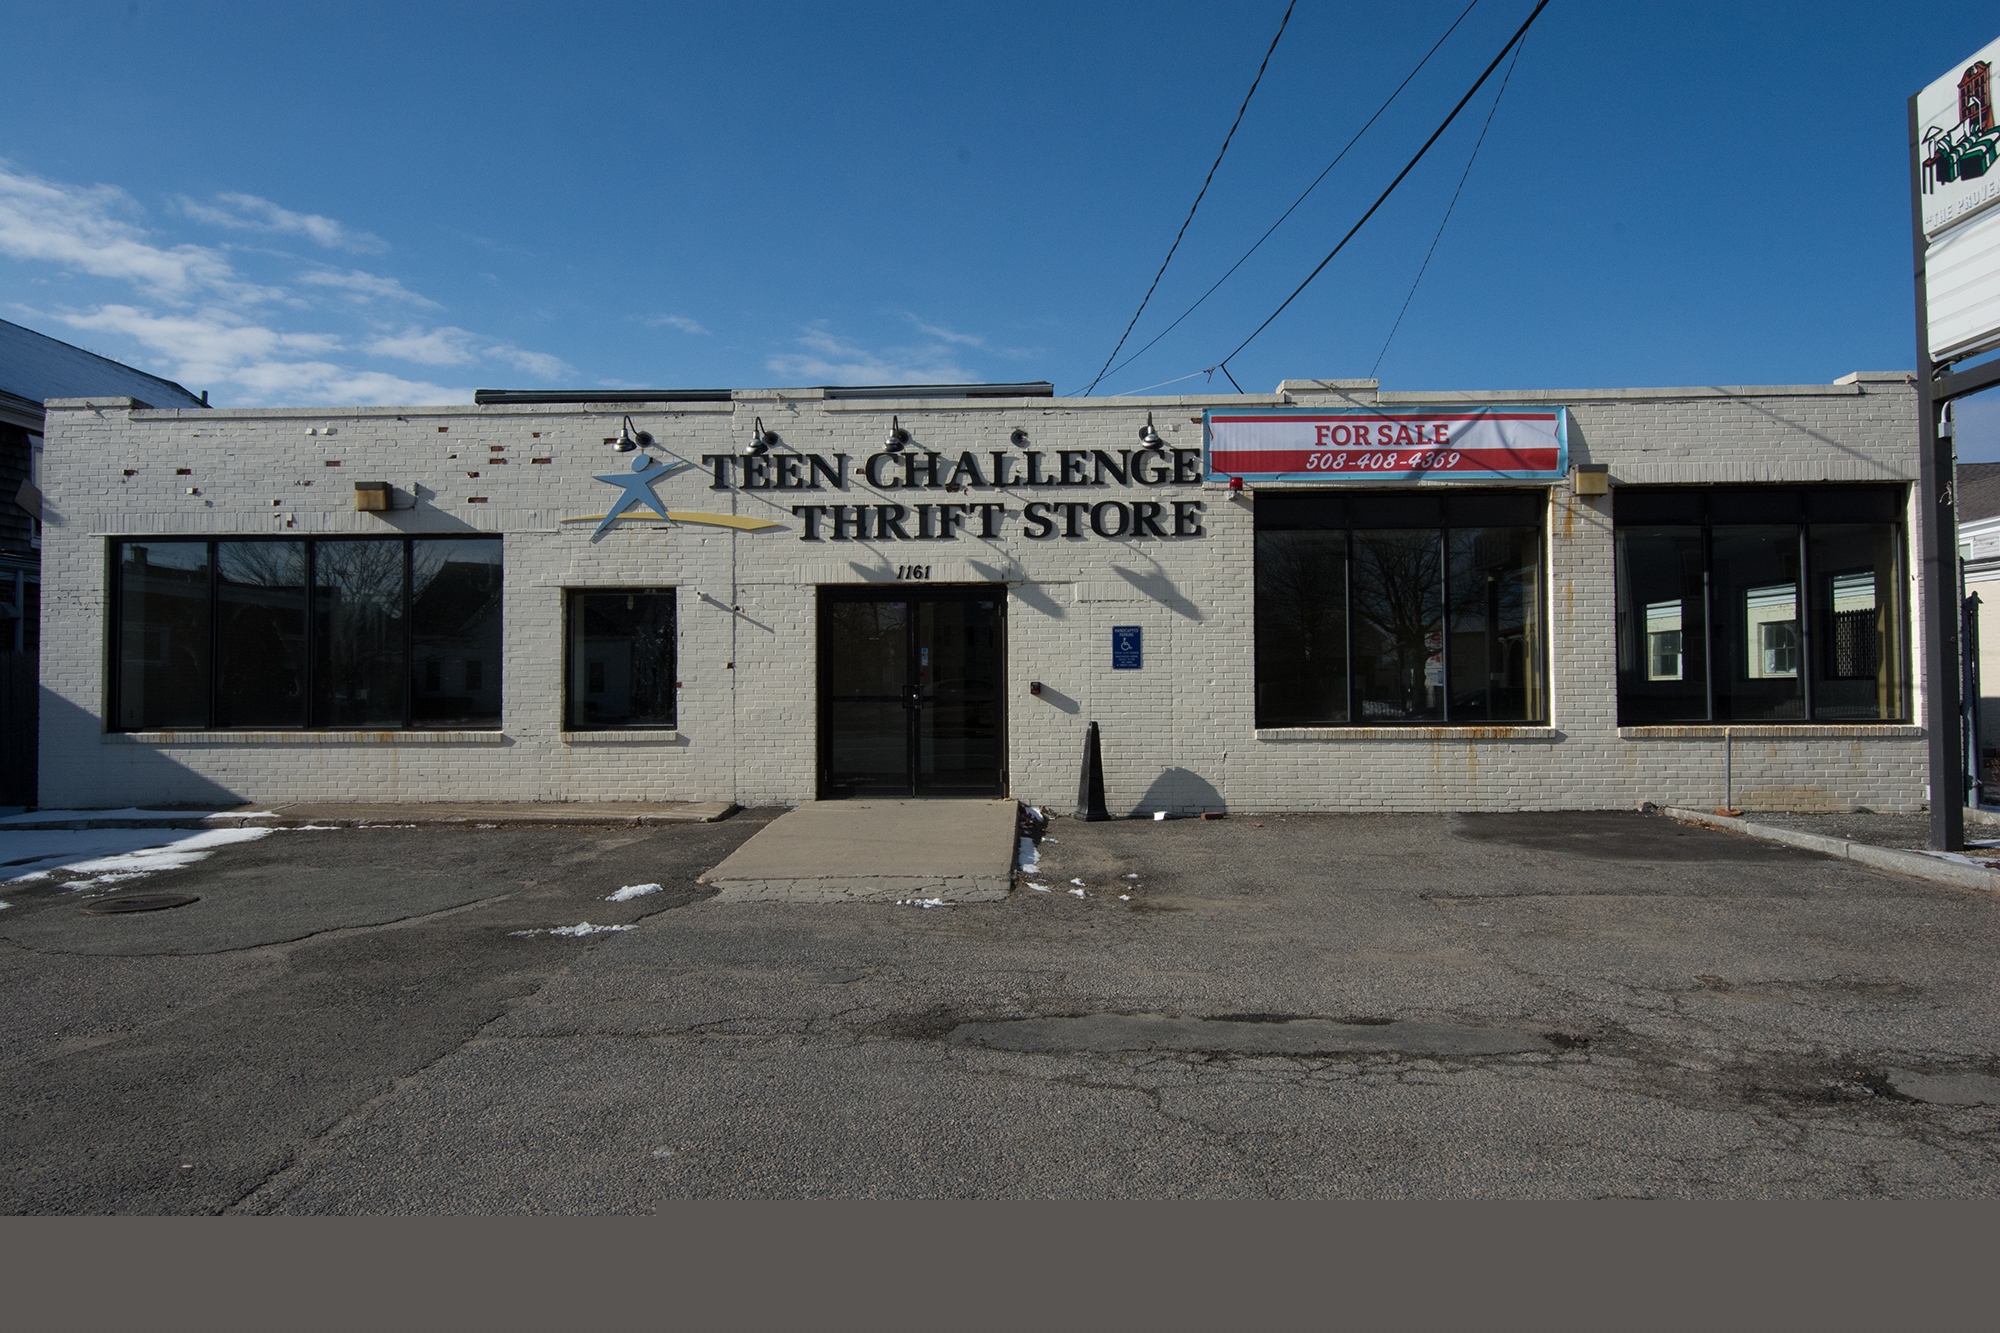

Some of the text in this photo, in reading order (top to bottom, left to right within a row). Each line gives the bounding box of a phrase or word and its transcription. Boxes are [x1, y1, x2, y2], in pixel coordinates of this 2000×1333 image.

[1314, 423, 1450, 446] FOR SALE
[702, 448, 1201, 490] TEEN CHALLENGE
[1306, 451, 1461, 470] 508-408-4369
[792, 500, 1201, 541] THRIFT STORE
[897, 564, 931, 580] 1161
